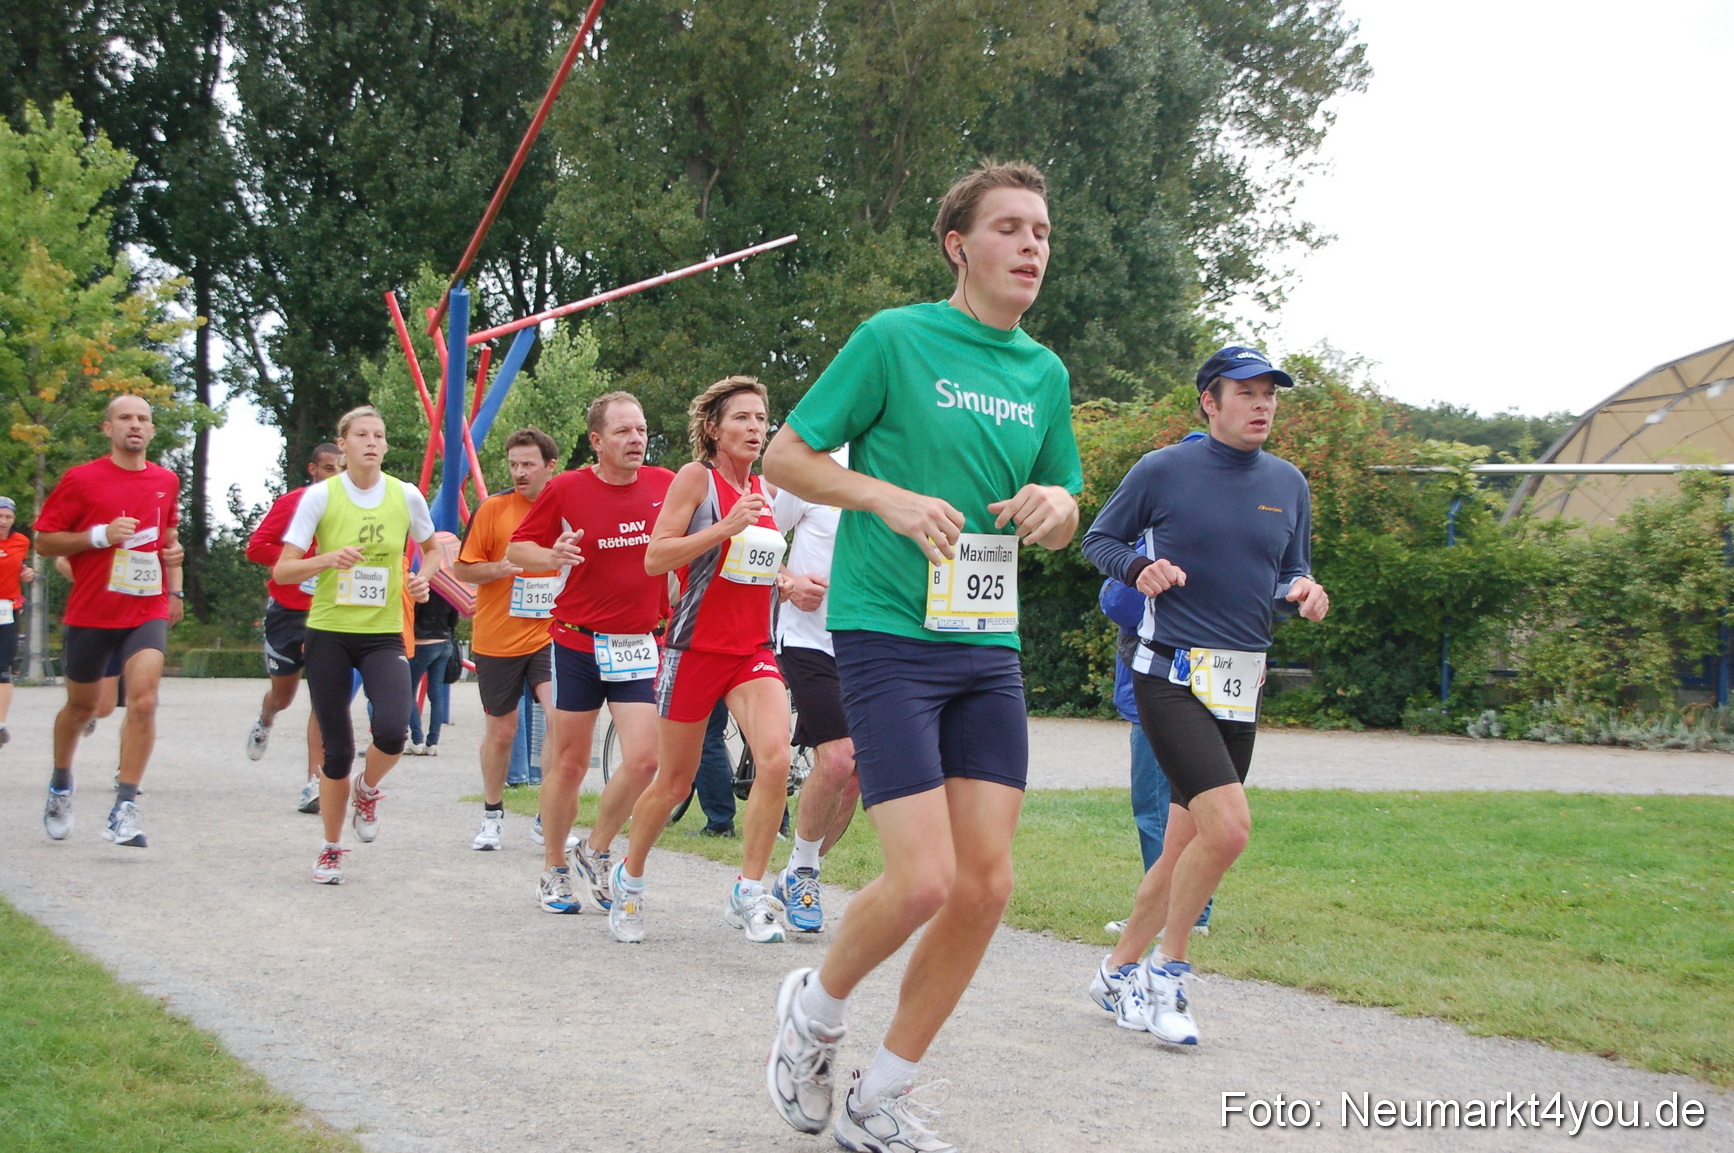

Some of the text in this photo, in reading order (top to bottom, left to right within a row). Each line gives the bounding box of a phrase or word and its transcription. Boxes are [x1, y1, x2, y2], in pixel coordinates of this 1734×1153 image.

[935, 379, 1035, 428] Sinupret
[619, 520, 646, 534] DAV
[749, 549, 775, 567] 958
[960, 543, 1012, 562] Maximilian
[133, 569, 158, 582] 233
[354, 570, 383, 581] Claudia
[934, 571, 941, 585] B
[359, 585, 386, 600] 331
[526, 581, 549, 590] Gerhard
[967, 574, 1005, 600] 925
[526, 592, 553, 604] 3150
[615, 647, 652, 662] 3042
[1213, 655, 1233, 669] Dirk
[1195, 676, 1201, 685] B
[1223, 678, 1242, 697] 43
